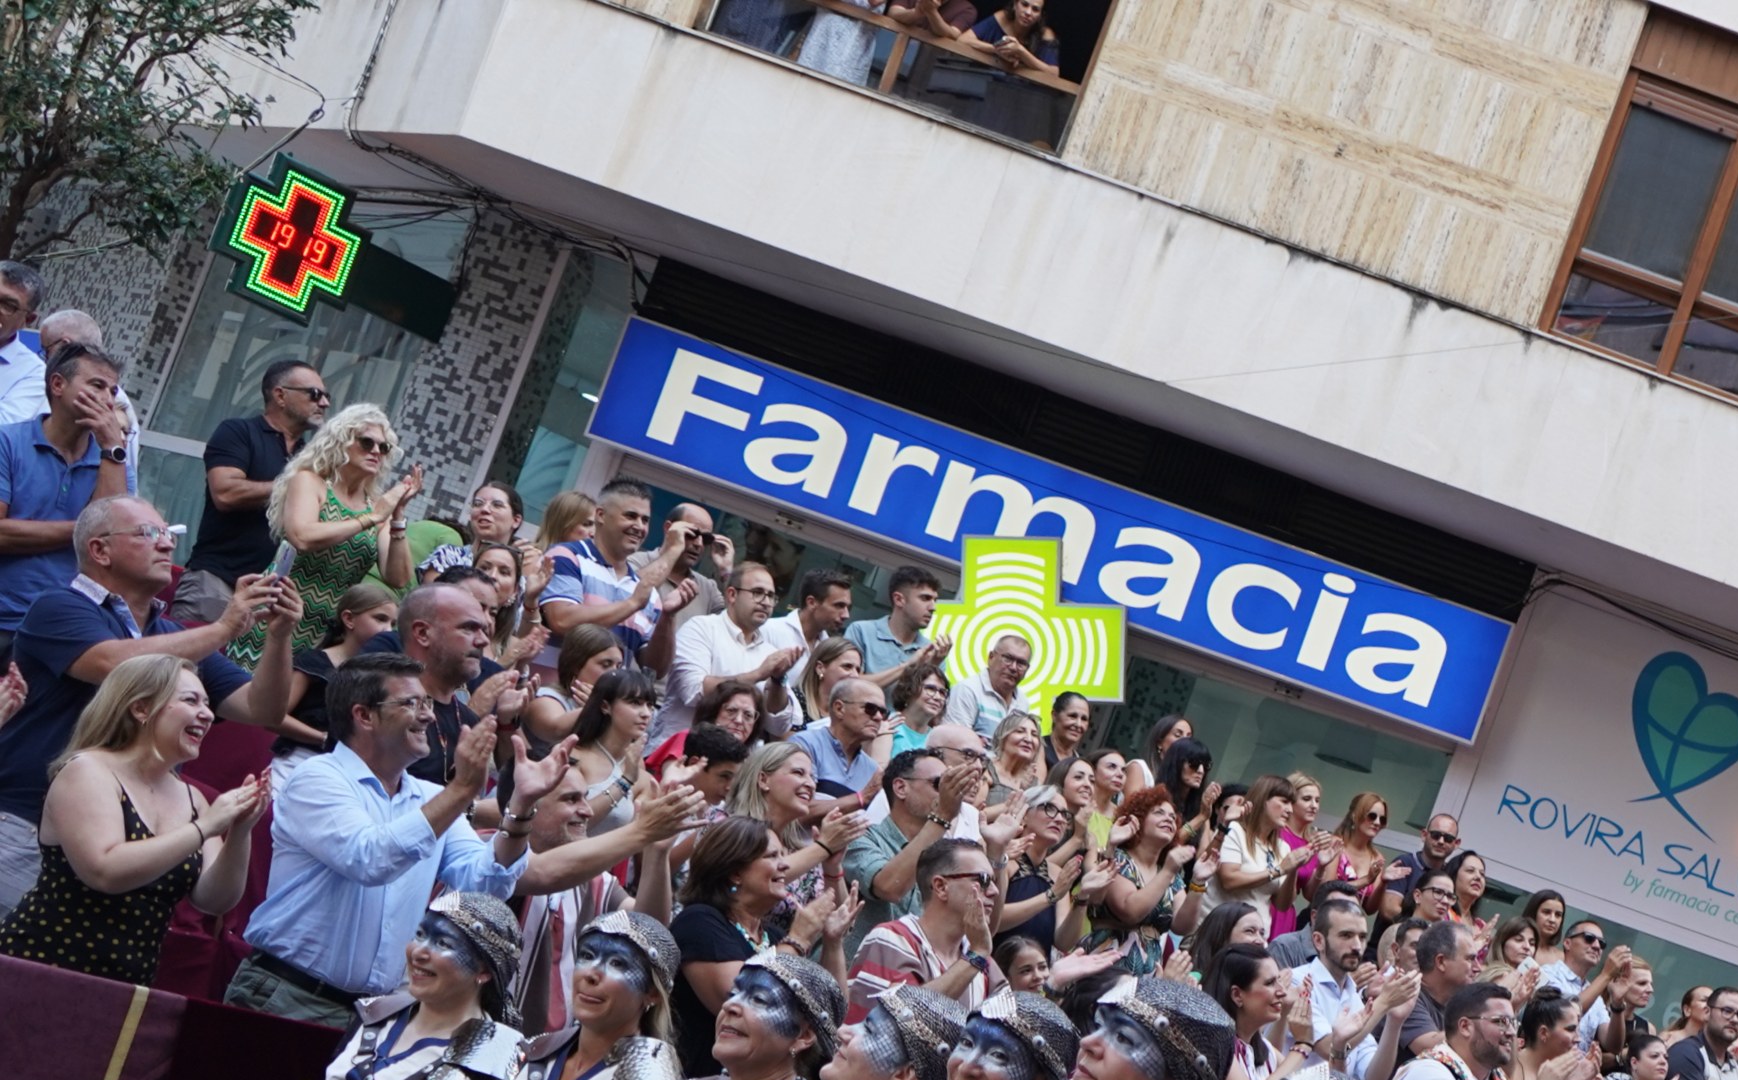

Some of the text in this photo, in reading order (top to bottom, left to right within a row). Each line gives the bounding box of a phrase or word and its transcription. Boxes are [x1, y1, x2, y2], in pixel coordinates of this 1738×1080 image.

[270, 220, 328, 264] 19 19
[646, 348, 1448, 708] Farmacia
[1497, 784, 1645, 865] ROVIRA
[1623, 869, 1644, 893] by
[1649, 878, 1721, 917] farmacia
